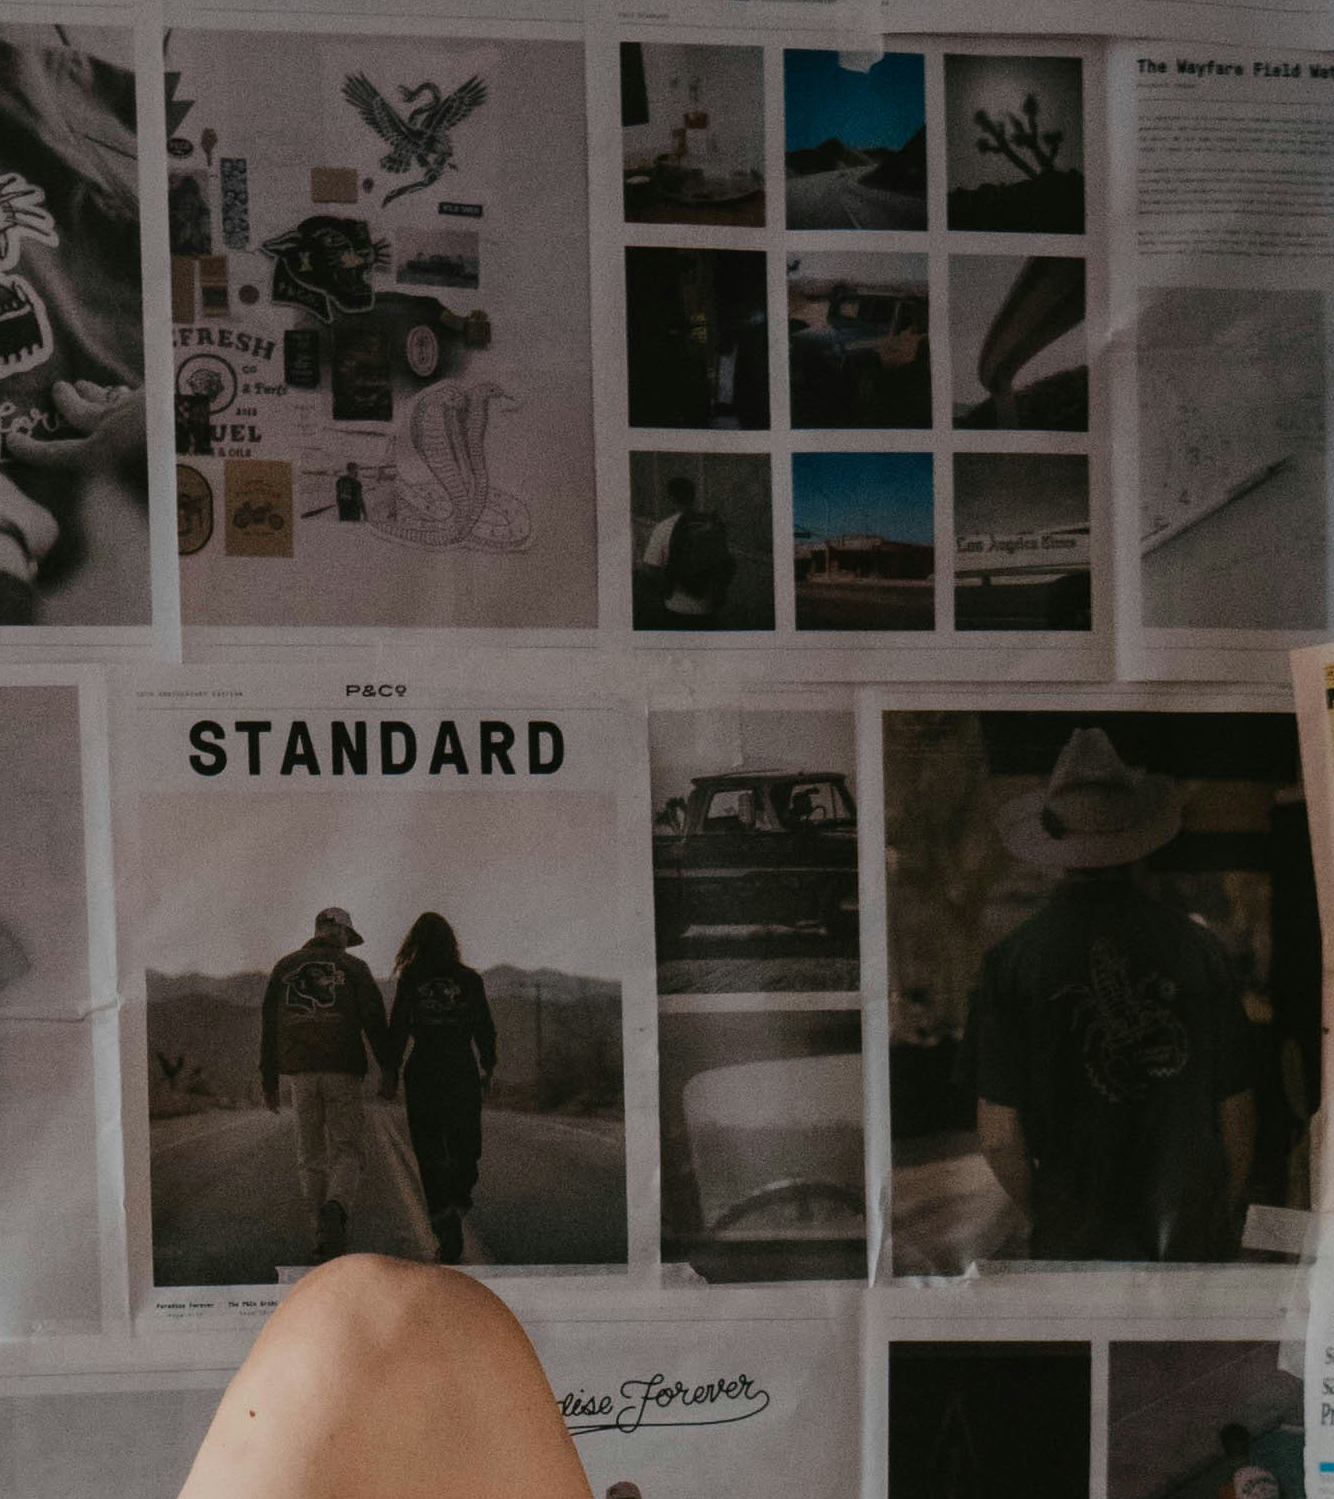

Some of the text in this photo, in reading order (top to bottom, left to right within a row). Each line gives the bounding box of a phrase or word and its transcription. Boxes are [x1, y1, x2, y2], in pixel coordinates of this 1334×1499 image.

[1137, 58, 1169, 76] The
[1176, 60, 1245, 80] Wayfare
[1252, 61, 1301, 80] Field
[955, 533, 985, 554] Los
[985, 533, 1039, 554] Angeles
[188, 718, 567, 778] STANDARD
[614, 1368, 771, 1435] Forever
